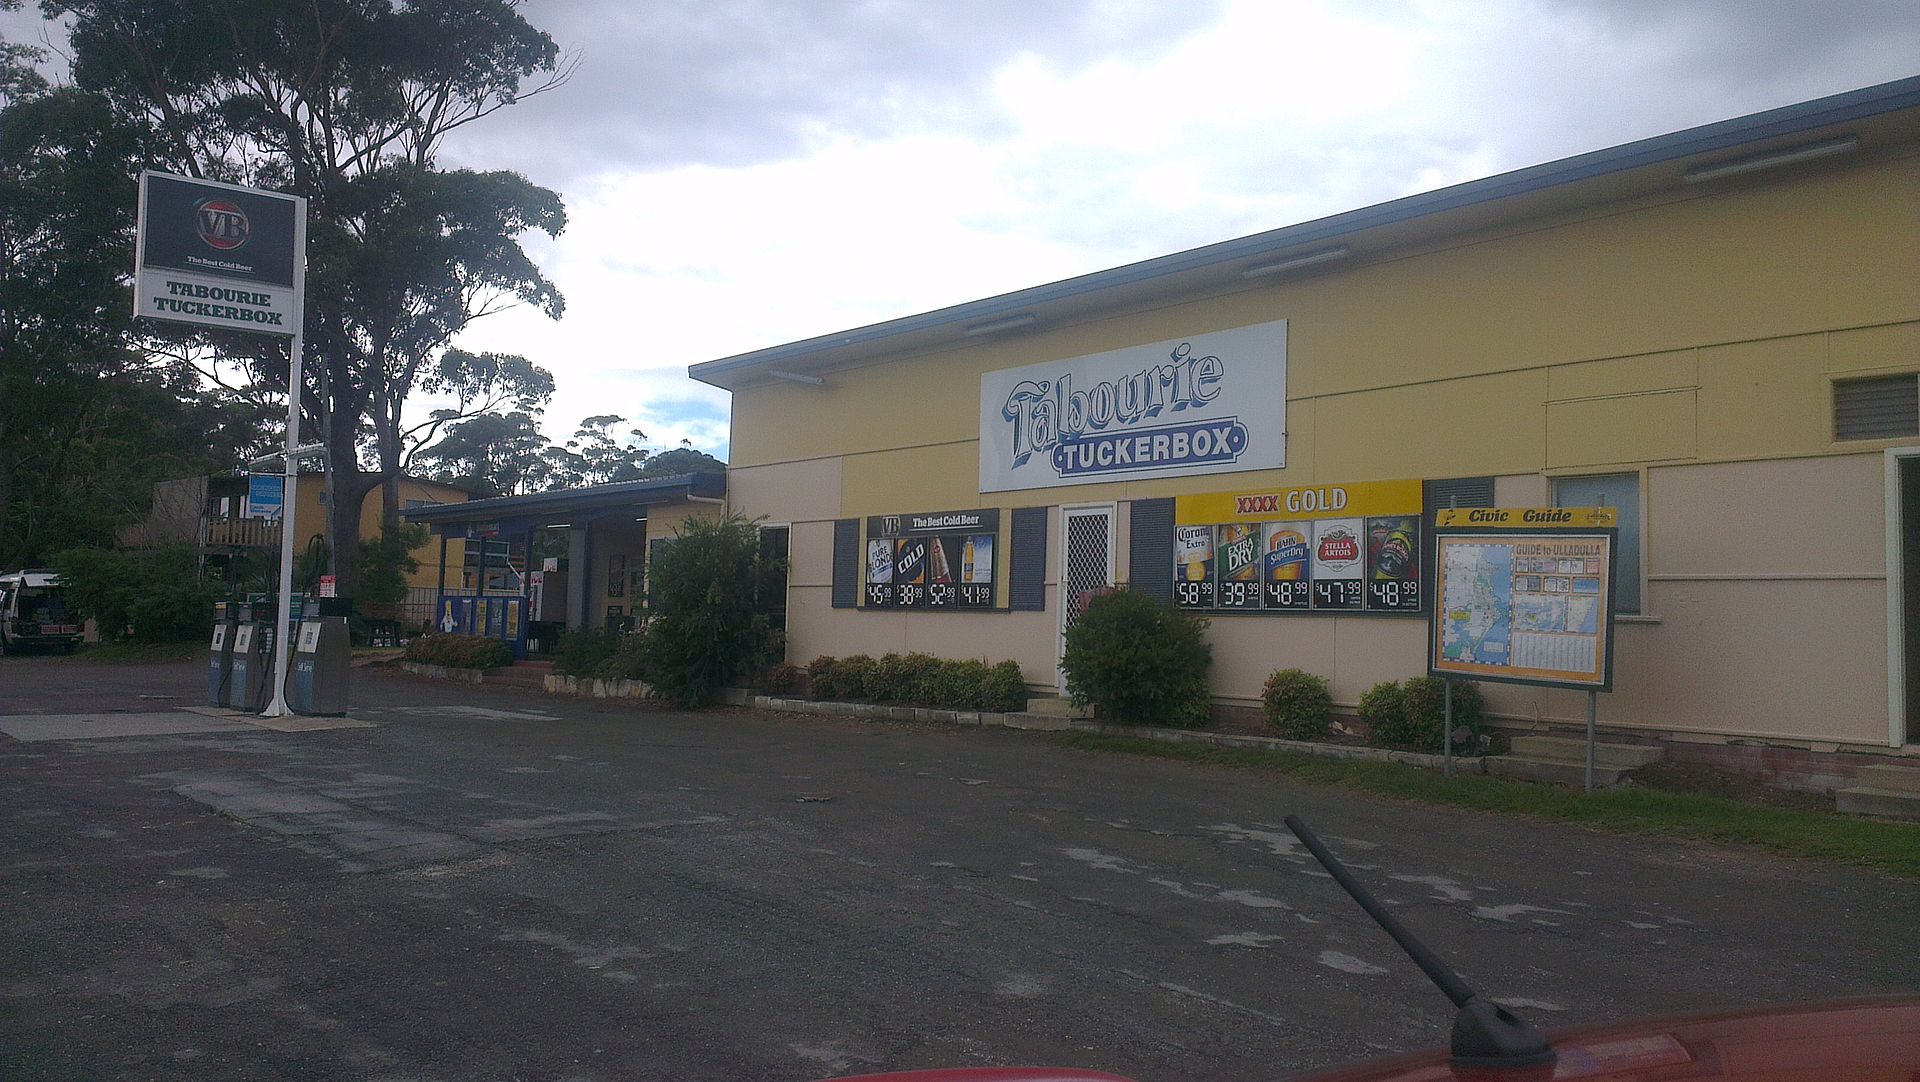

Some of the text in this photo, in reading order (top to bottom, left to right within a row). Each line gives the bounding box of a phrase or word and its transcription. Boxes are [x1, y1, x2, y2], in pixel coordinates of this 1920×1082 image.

[200, 210, 246, 240] VB
[187, 255, 253, 272] The Best Cold Beer
[166, 281, 271, 308] TABOURIE
[153, 297, 283, 326] TUCKERBOX
[1003, 342, 1224, 466] Tabourie
[1062, 427, 1234, 469] TUCKERBOX
[1237, 487, 1348, 513] XXXX GOLD
[913, 515, 980, 528] The Best Cold Beer
[1468, 509, 1510, 523] Civic
[1522, 508, 1572, 523] Guide
[883, 517, 899, 534] VB
[1186, 540, 1206, 549] Extra
[1228, 538, 1254, 555] EXTRA
[1276, 535, 1297, 550] HAHN
[1324, 542, 1351, 550] STELLA
[1516, 543, 1600, 556] GUIDE to ULLADULLA
[872, 545, 888, 560] PURE
[897, 543, 924, 574] COLD
[1228, 545, 1254, 571] DRY
[1270, 546, 1304, 565] SuperDry
[1324, 549, 1351, 557] ARTOIS
